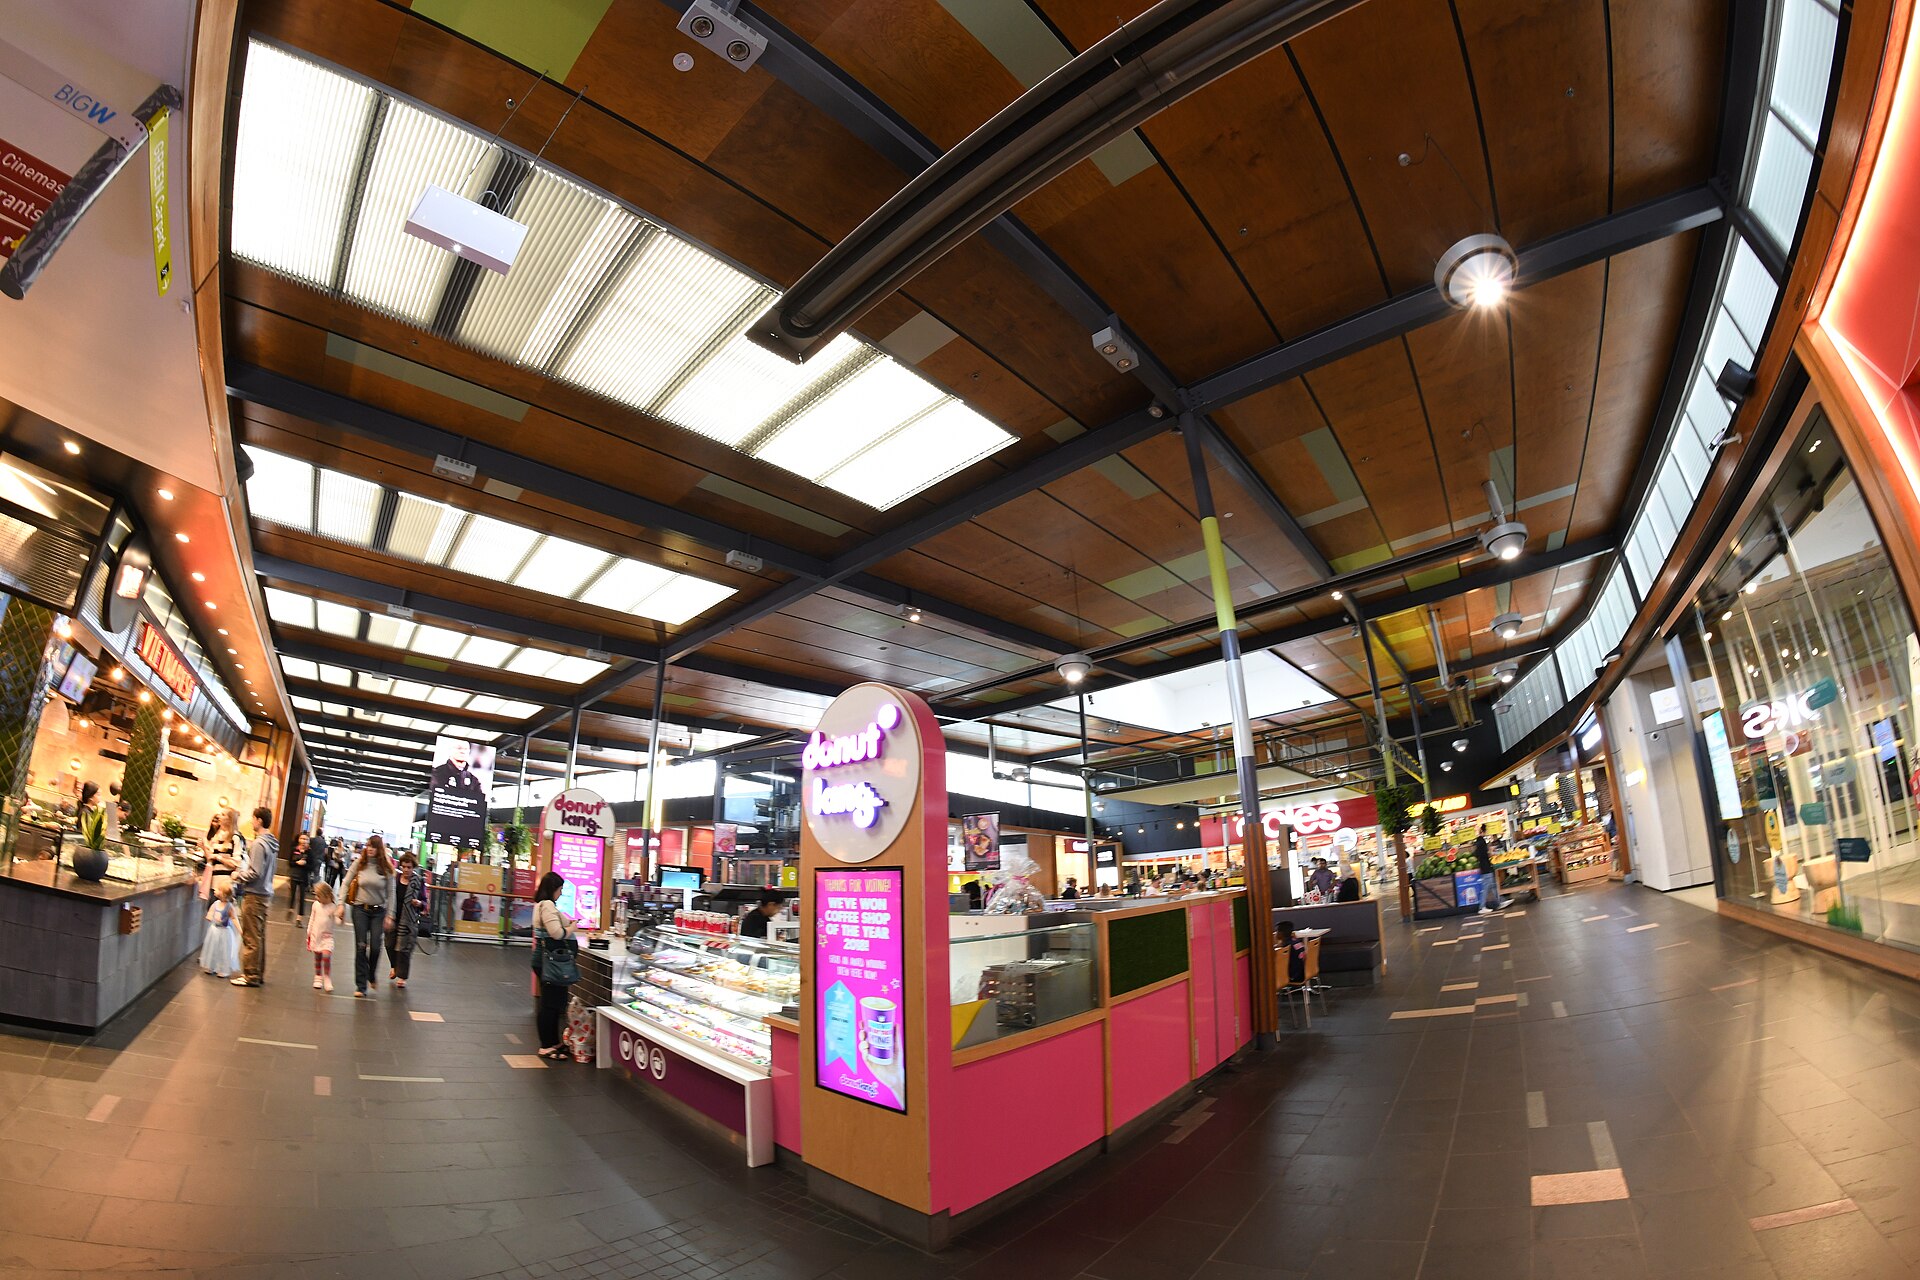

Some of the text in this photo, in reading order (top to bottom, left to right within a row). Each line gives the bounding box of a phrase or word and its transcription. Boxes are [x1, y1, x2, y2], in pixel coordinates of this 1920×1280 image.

[2, 151, 66, 195] Cinemas
[153, 139, 167, 253] GREEN Carpark
[802, 722, 886, 771] donut
[554, 794, 605, 816] donut
[812, 776, 890, 829] king
[561, 810, 603, 835] king
[859, 897, 888, 911] WON
[824, 910, 891, 925] COFFEE SHOP
[825, 923, 891, 940] OF THE YEAR
